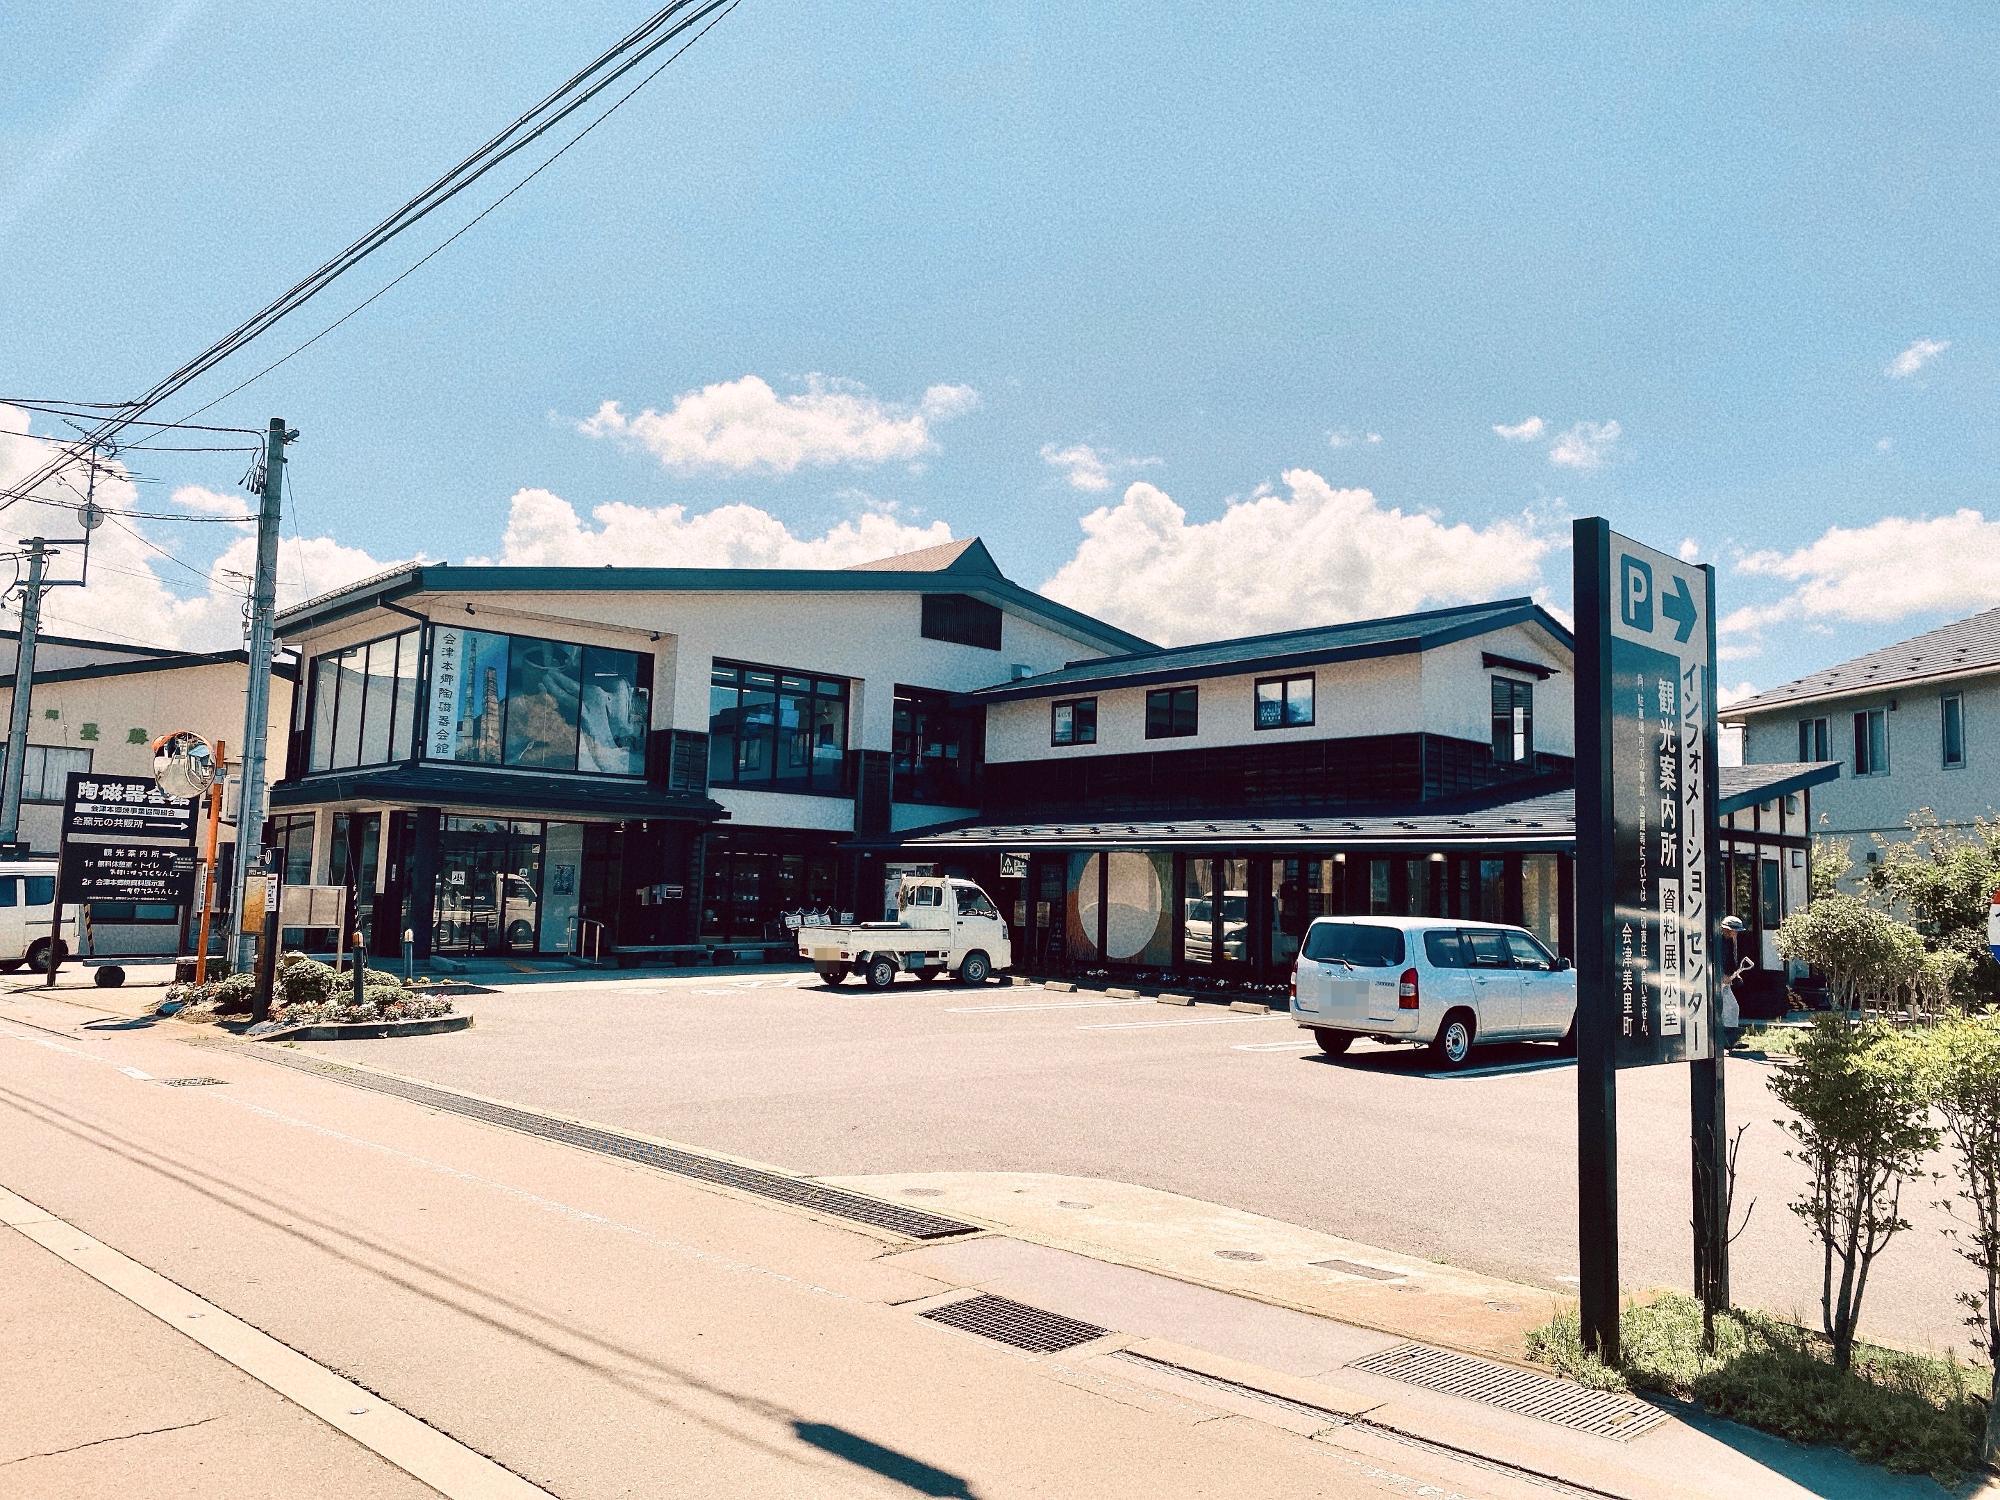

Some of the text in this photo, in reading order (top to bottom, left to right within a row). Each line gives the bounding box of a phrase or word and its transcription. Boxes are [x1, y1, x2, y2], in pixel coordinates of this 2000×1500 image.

[1628, 565, 1648, 621] P
[434, 632, 457, 754] 会津本郷陶磁器会館
[77, 780, 190, 807] 陶磁器会
[1658, 676, 1677, 868] 観光案内所
[81, 878, 92, 886] 2F
[84, 860, 94, 868] 1F
[1683, 662, 1704, 1051] インフォメーションセンター
[1621, 922, 1634, 1038] 会津美里町
[1663, 887, 1678, 1027] 資料展示室
